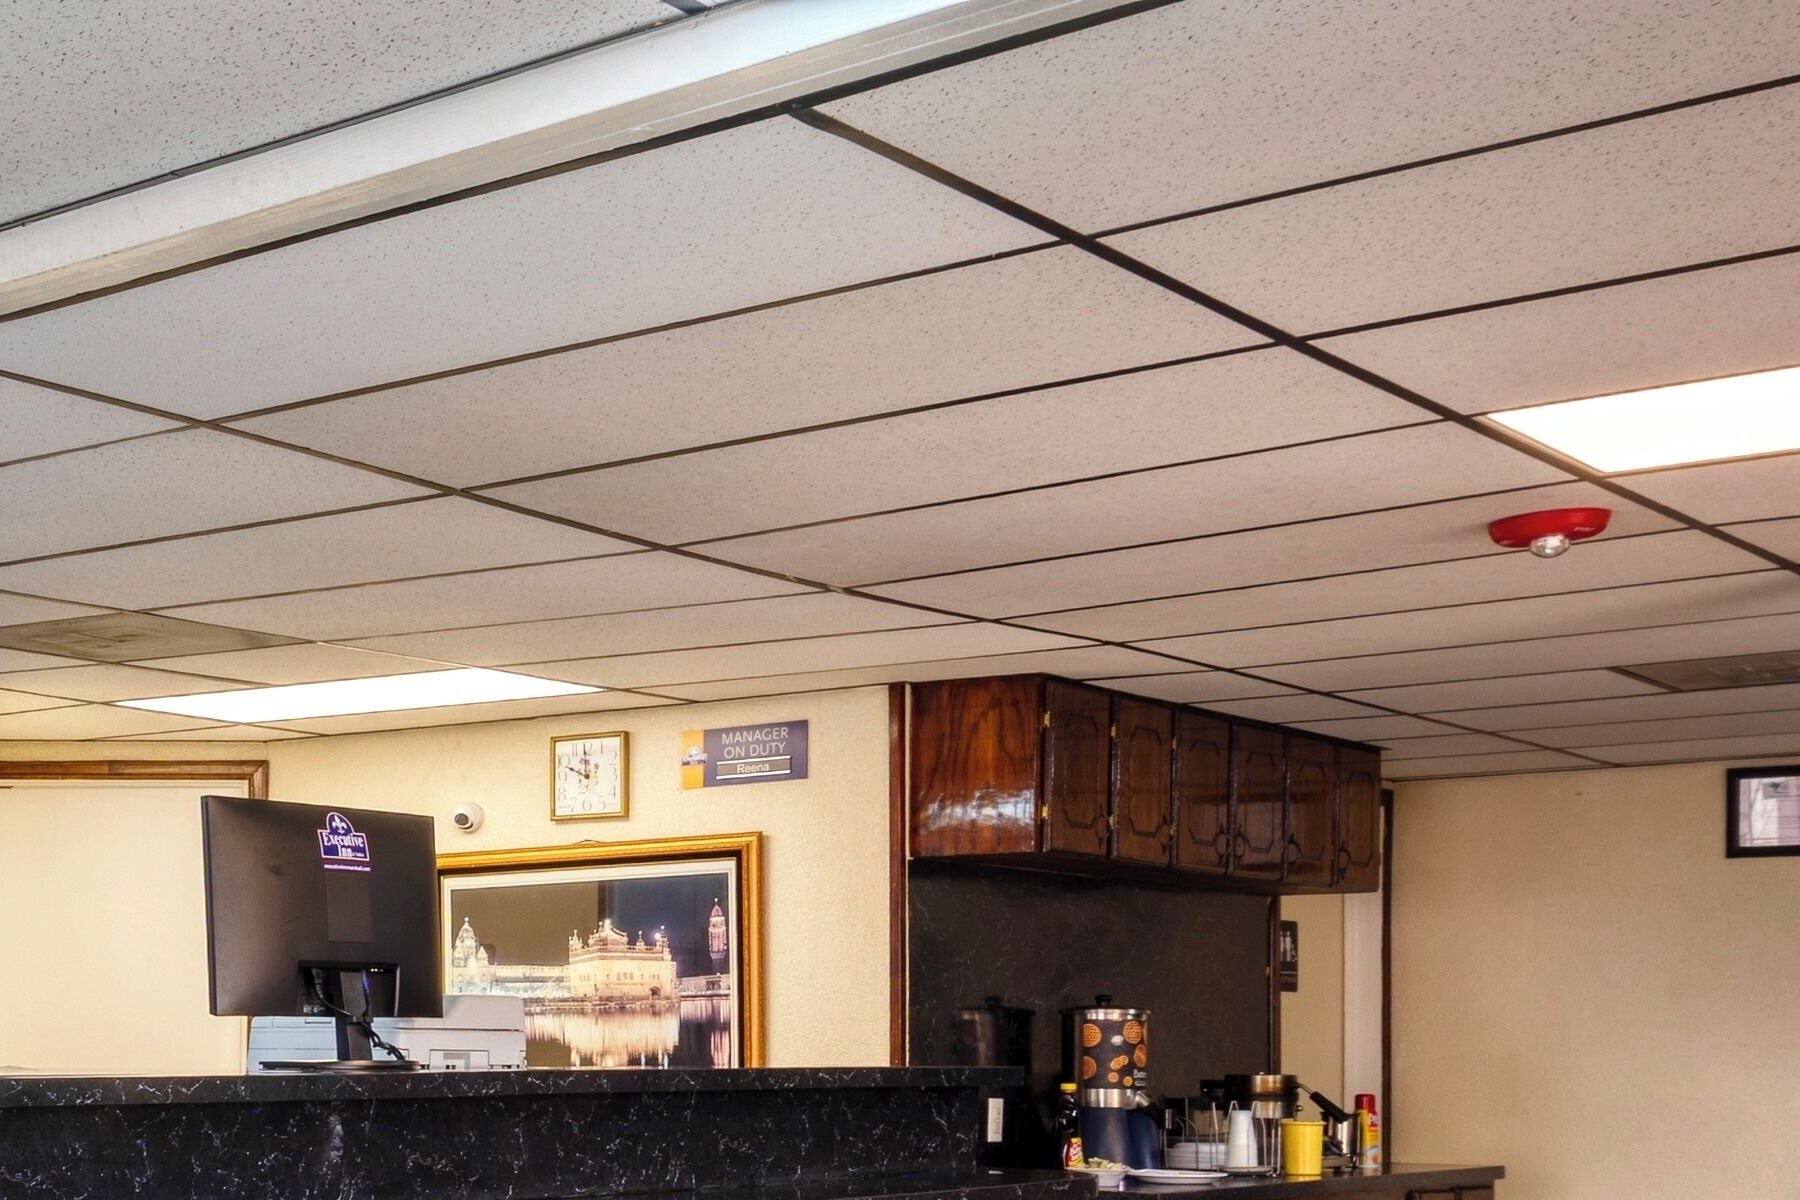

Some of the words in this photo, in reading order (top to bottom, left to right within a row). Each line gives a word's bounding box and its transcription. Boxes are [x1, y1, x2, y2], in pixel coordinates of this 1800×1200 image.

[721, 727, 789, 745] MANAGER
[723, 746, 745, 759] ON
[750, 742, 786, 757] DUTY
[736, 763, 770, 774] Reena
[322, 832, 364, 847] Executive
